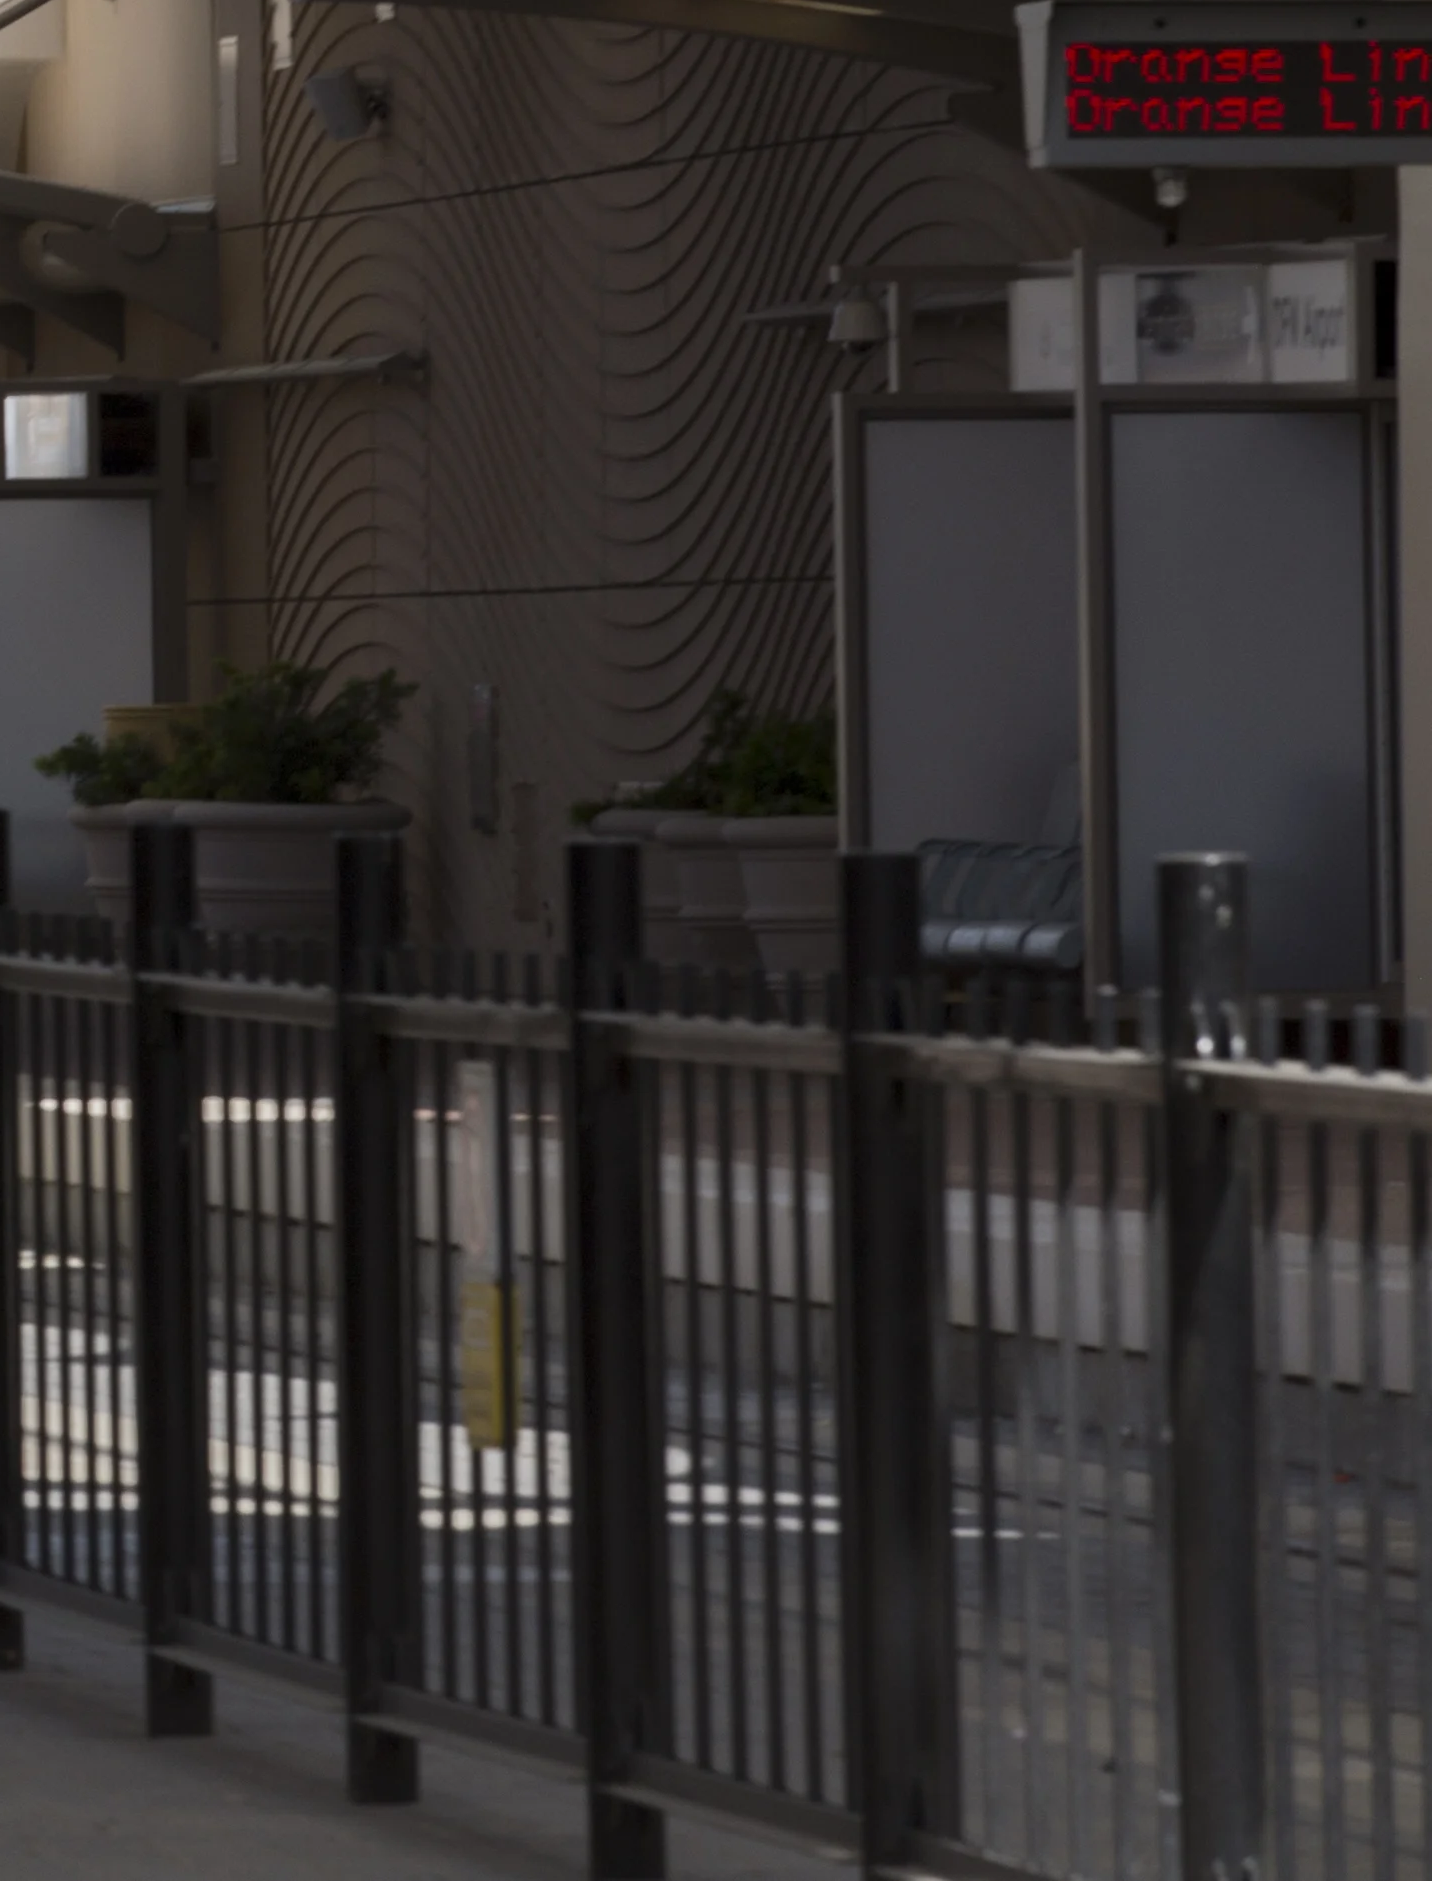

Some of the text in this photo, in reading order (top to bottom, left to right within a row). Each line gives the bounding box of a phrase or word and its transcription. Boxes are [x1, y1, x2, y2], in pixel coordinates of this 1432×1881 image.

[1065, 40, 1432, 83] Orange Lin
[1065, 87, 1432, 131] Orange Lin
